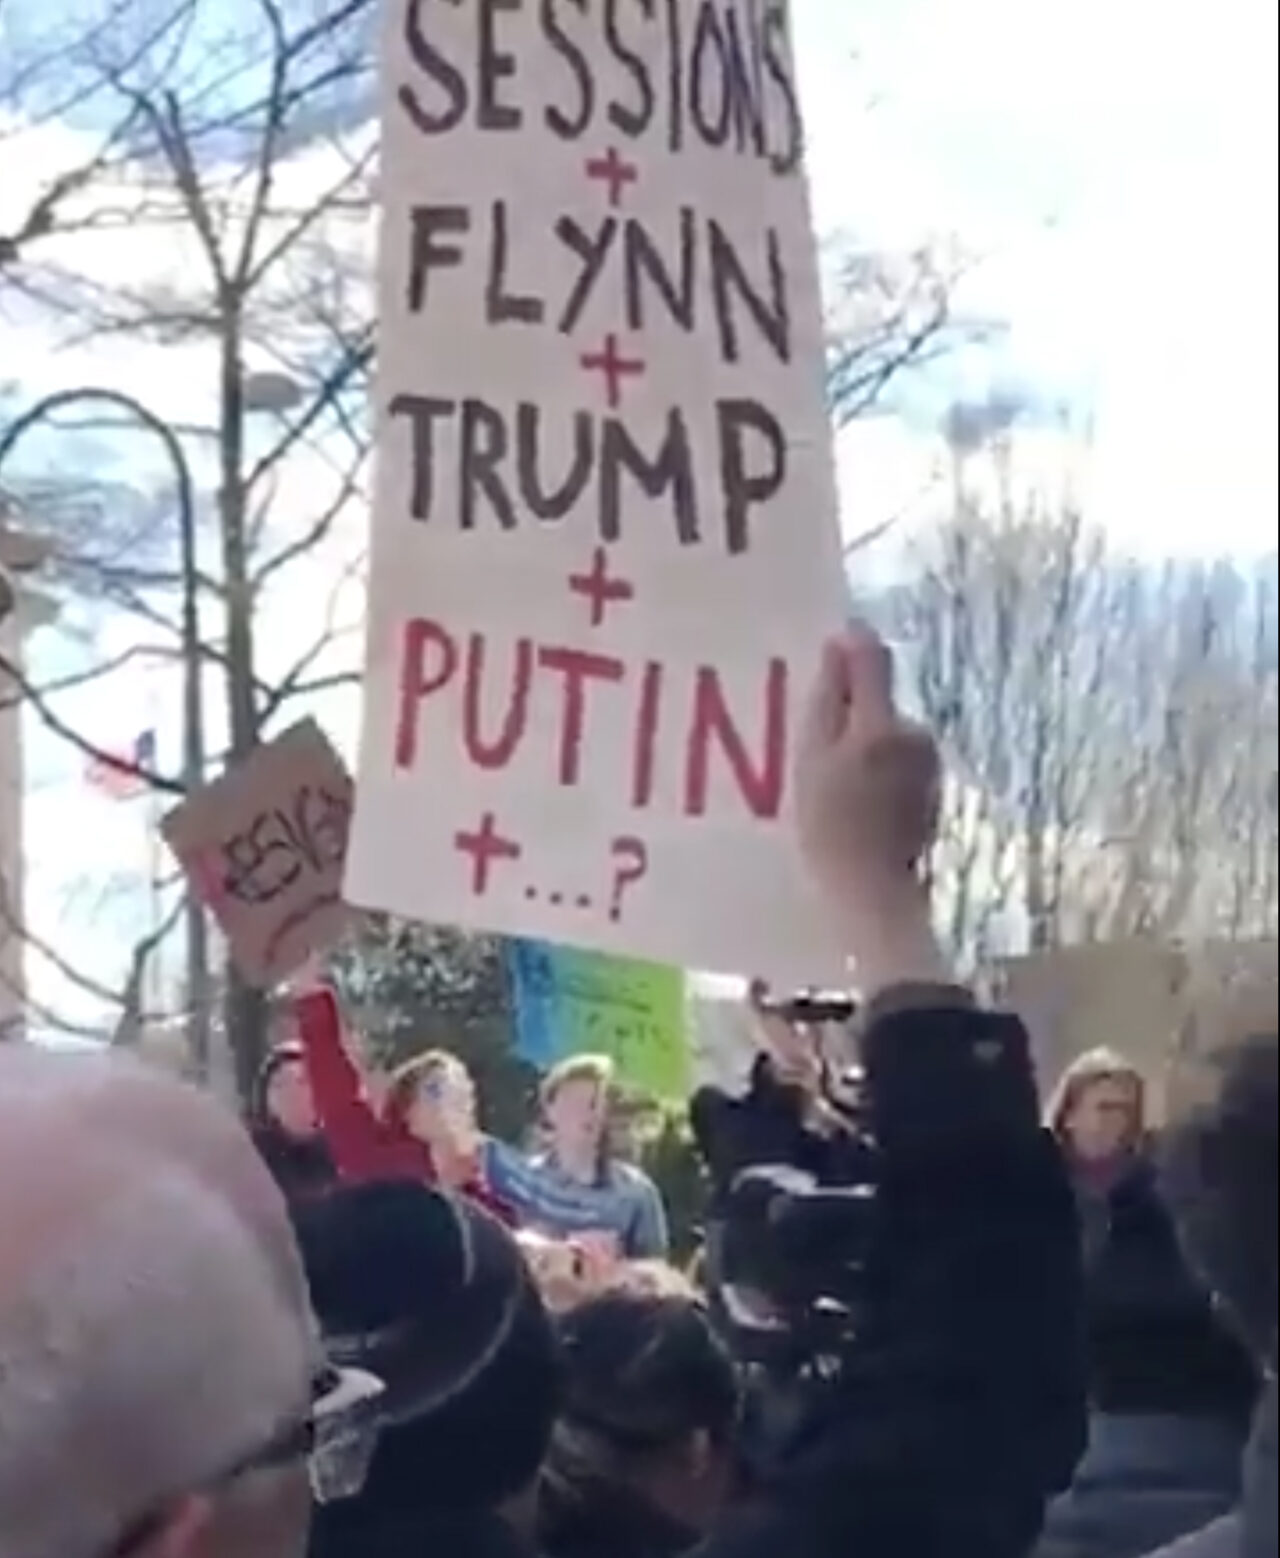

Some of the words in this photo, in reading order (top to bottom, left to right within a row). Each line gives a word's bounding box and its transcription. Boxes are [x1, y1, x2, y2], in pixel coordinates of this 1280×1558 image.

[398, 0, 803, 175] SESSIONS
[408, 199, 790, 364] FLYNN
[388, 393, 786, 554] TRUMP
[394, 617, 788, 818] PUTIN
